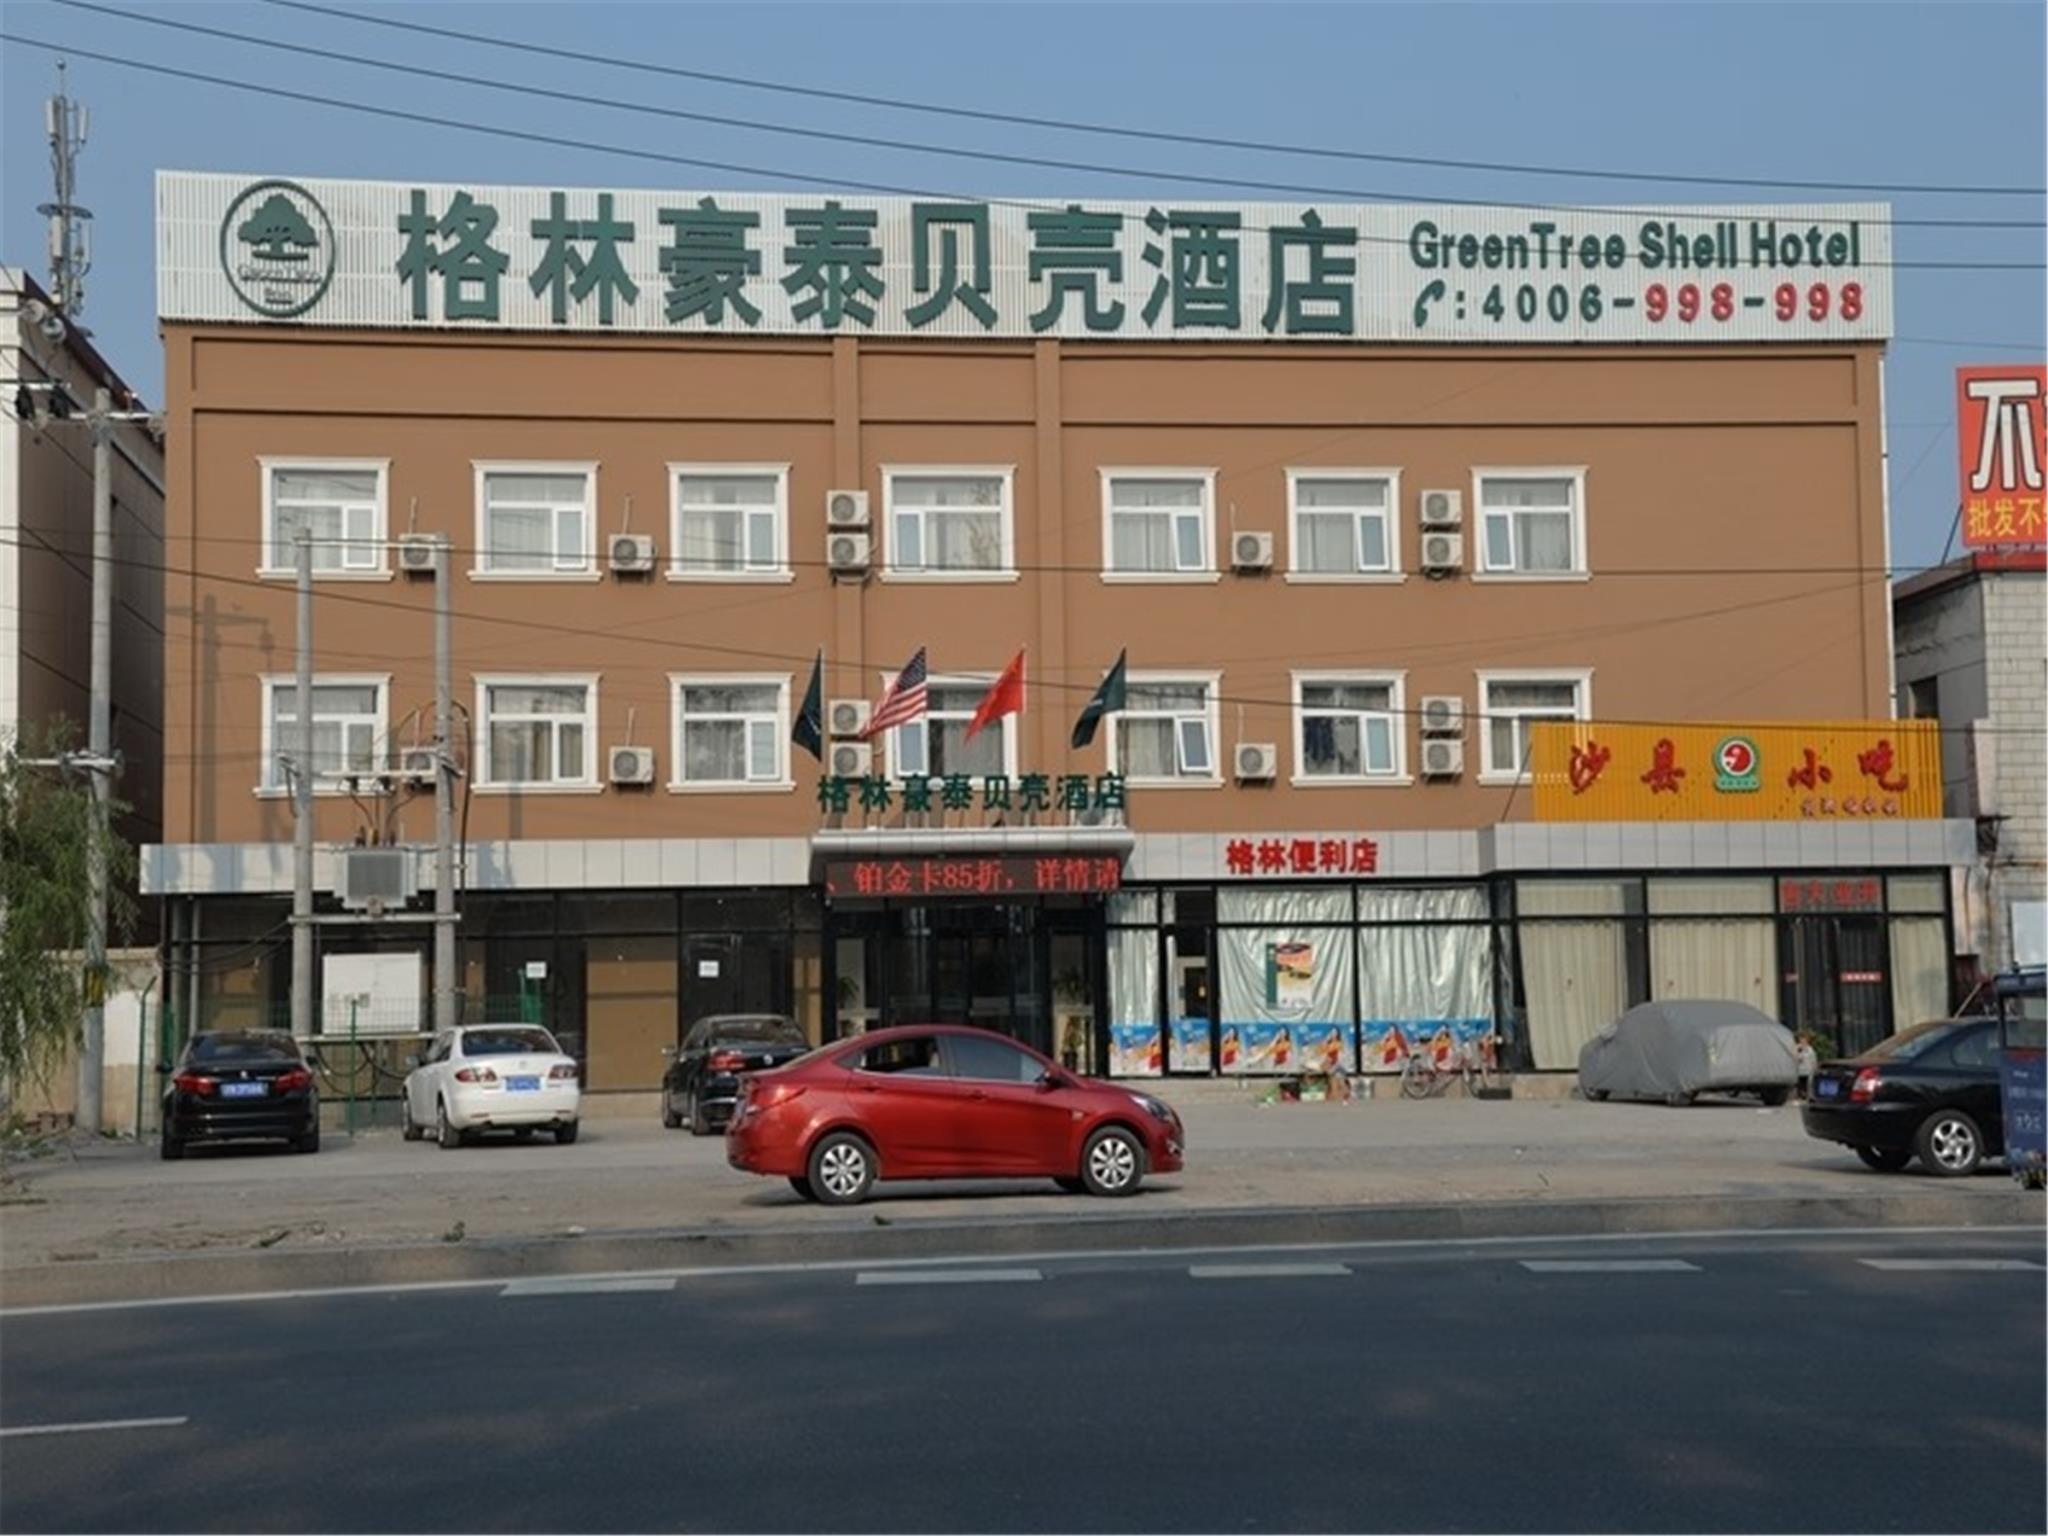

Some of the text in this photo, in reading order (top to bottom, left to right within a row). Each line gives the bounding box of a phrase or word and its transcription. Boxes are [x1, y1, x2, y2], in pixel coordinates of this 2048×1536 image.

[396, 188, 1358, 334] 格林豪泰贝壳酒店
[1409, 220, 1862, 269] GreenTree Shell Hotel
[1966, 377, 2047, 492] 不
[1968, 497, 2047, 538] 批发不
[817, 772, 1126, 814] 格林豪泰贝壳酒店
[1226, 838, 1378, 875] 格林便利店
